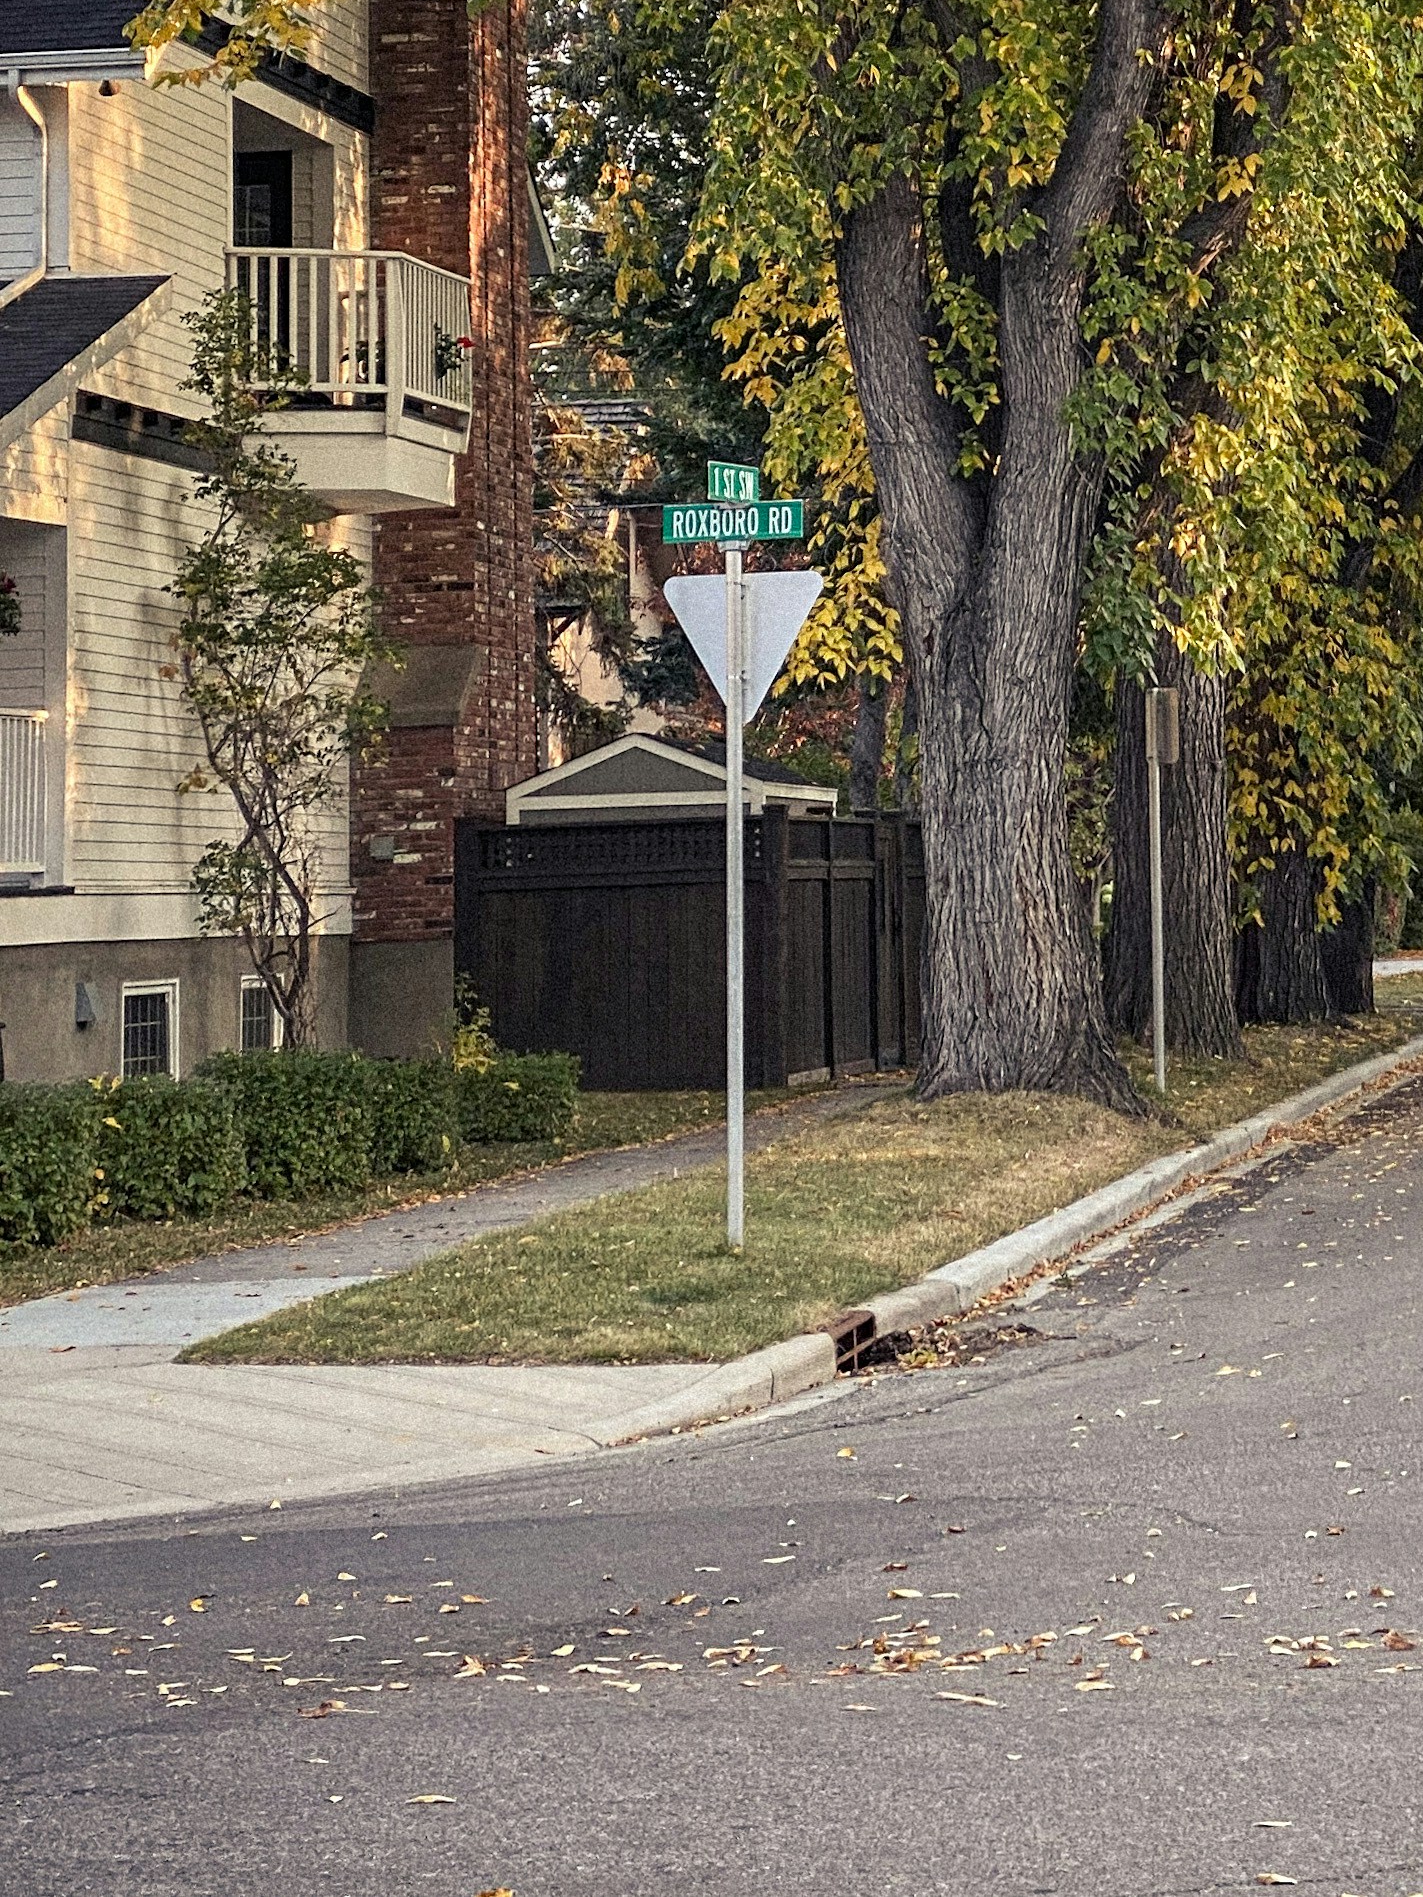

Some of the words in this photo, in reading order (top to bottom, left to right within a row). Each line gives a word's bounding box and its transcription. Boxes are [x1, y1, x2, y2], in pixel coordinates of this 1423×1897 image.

[714, 467, 720, 497] 1
[723, 468, 736, 499] ST
[739, 470, 754, 501] SW
[672, 507, 759, 539] ROXBORO
[768, 506, 793, 535] RD
